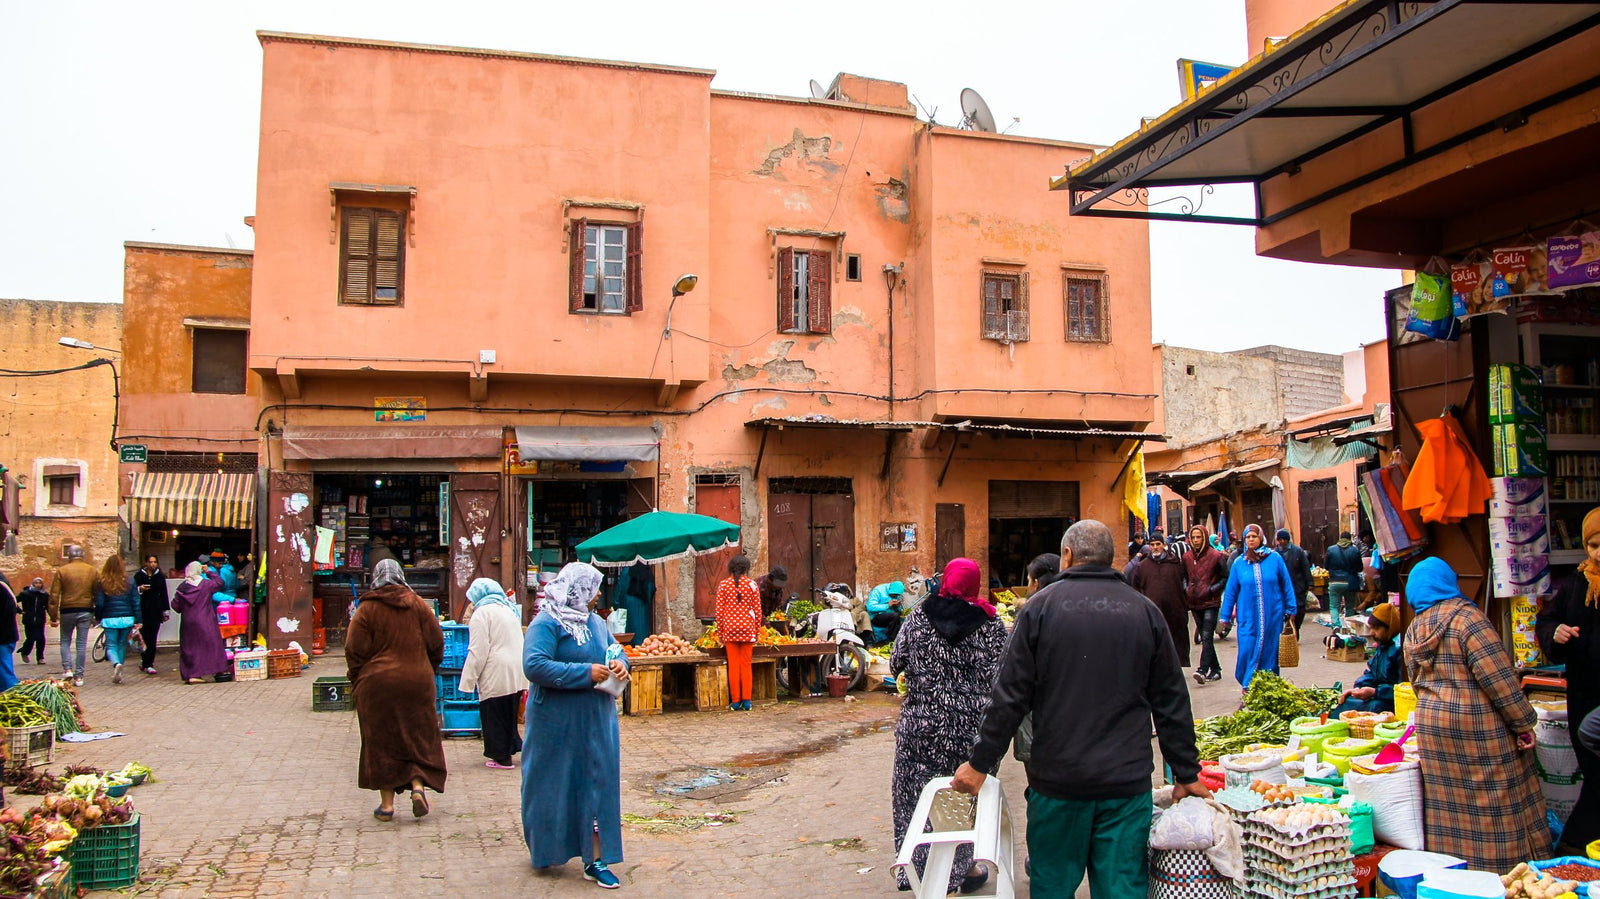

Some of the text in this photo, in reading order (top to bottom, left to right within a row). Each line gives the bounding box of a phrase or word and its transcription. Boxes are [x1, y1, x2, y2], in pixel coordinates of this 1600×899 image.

[1495, 252, 1525, 265] Calin
[1451, 270, 1477, 282] Calin
[1495, 282, 1504, 290] 32
[1507, 479, 1526, 492] Fine
[774, 503, 791, 513] 108
[1508, 518, 1528, 531] Fine
[1510, 559, 1529, 572] Fine
[328, 686, 338, 701] 3
